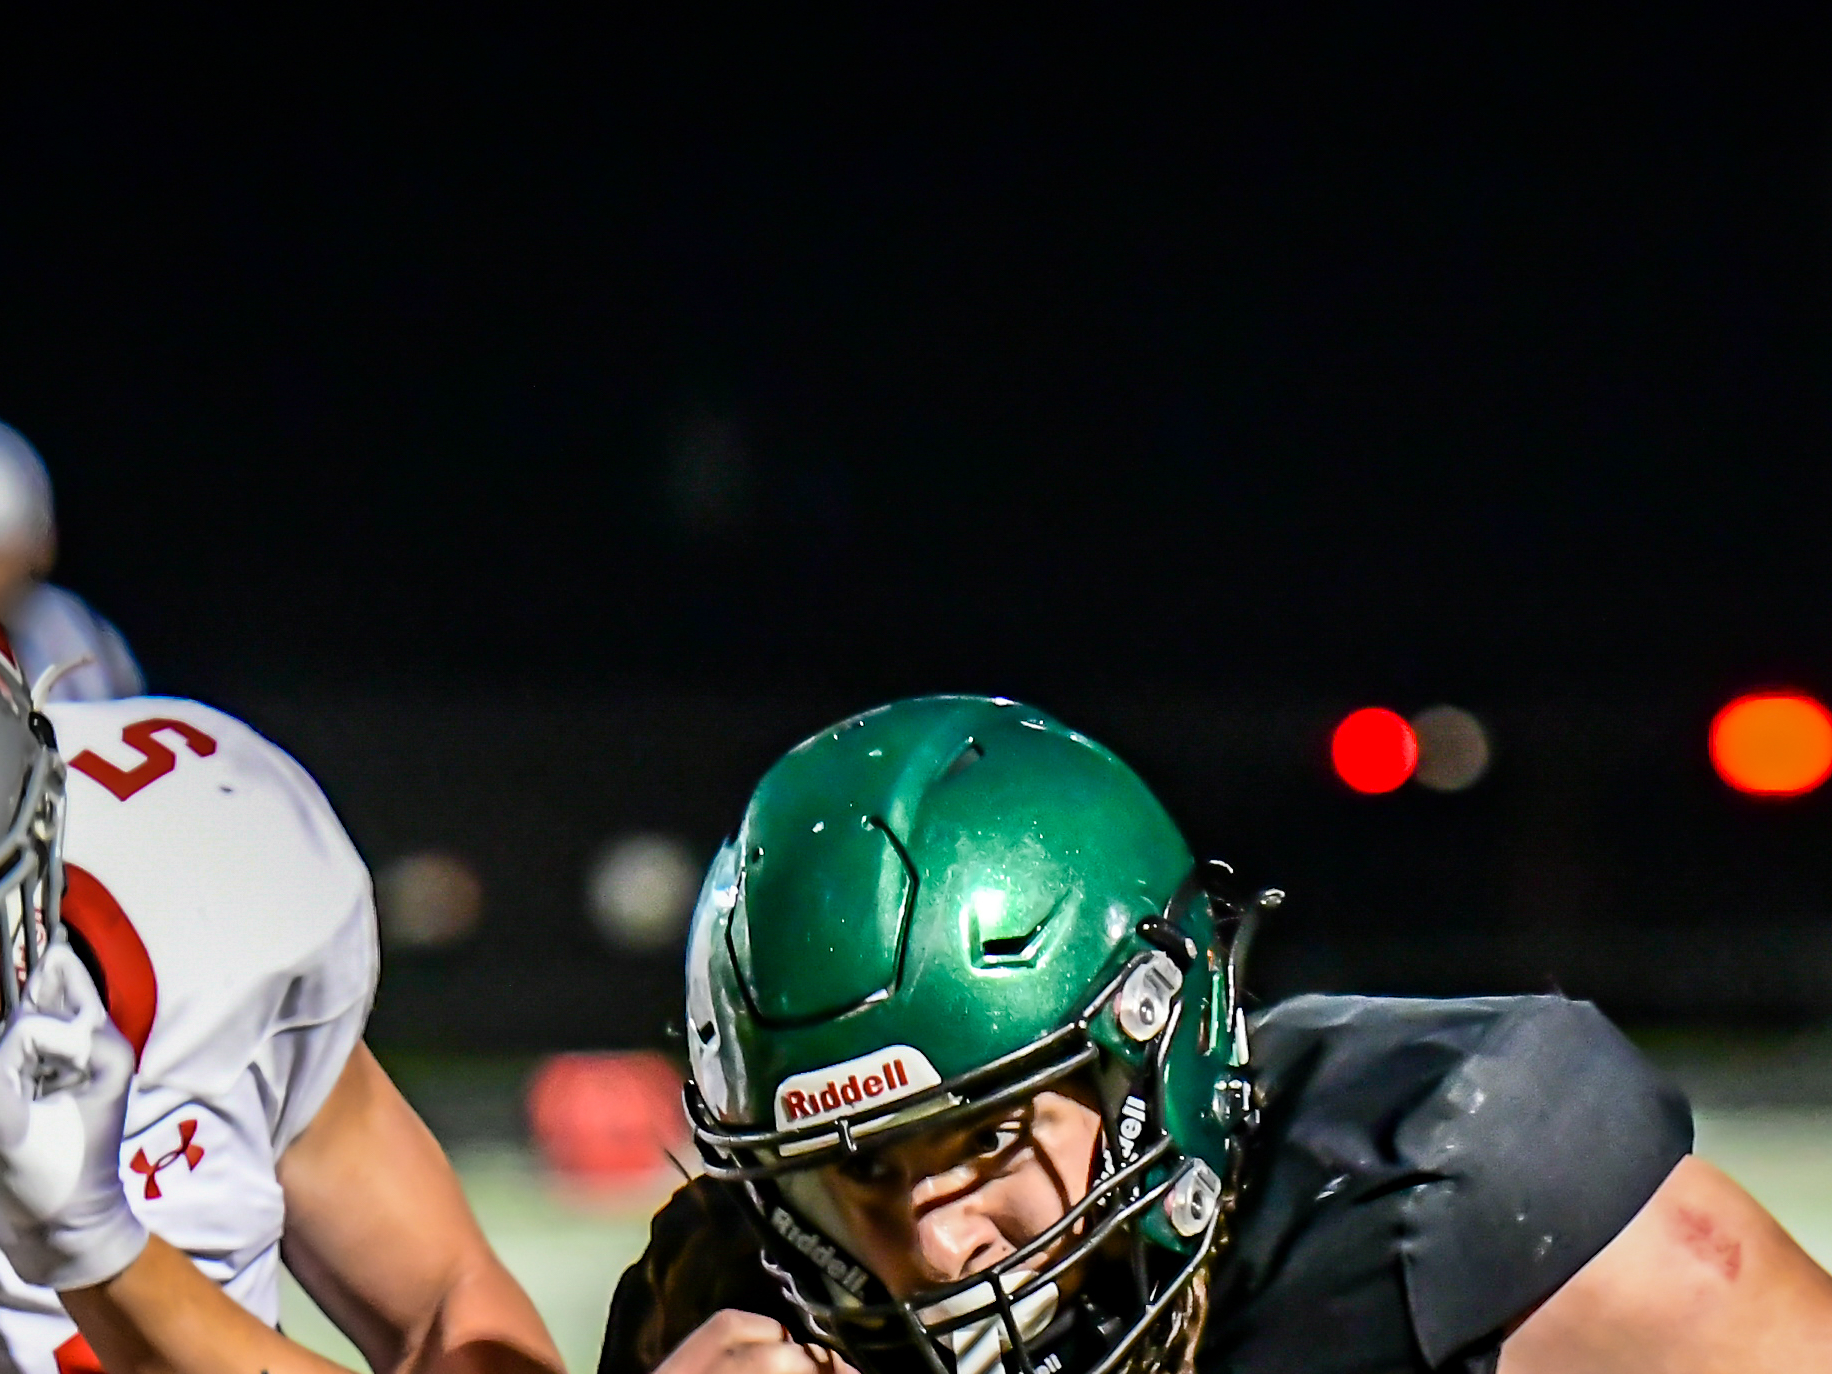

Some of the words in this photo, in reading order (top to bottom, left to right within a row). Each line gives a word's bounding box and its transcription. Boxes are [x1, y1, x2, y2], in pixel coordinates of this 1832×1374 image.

[67, 717, 217, 802] 5
[782, 1058, 909, 1123] Riddell
[771, 1205, 870, 1294] Riddell
